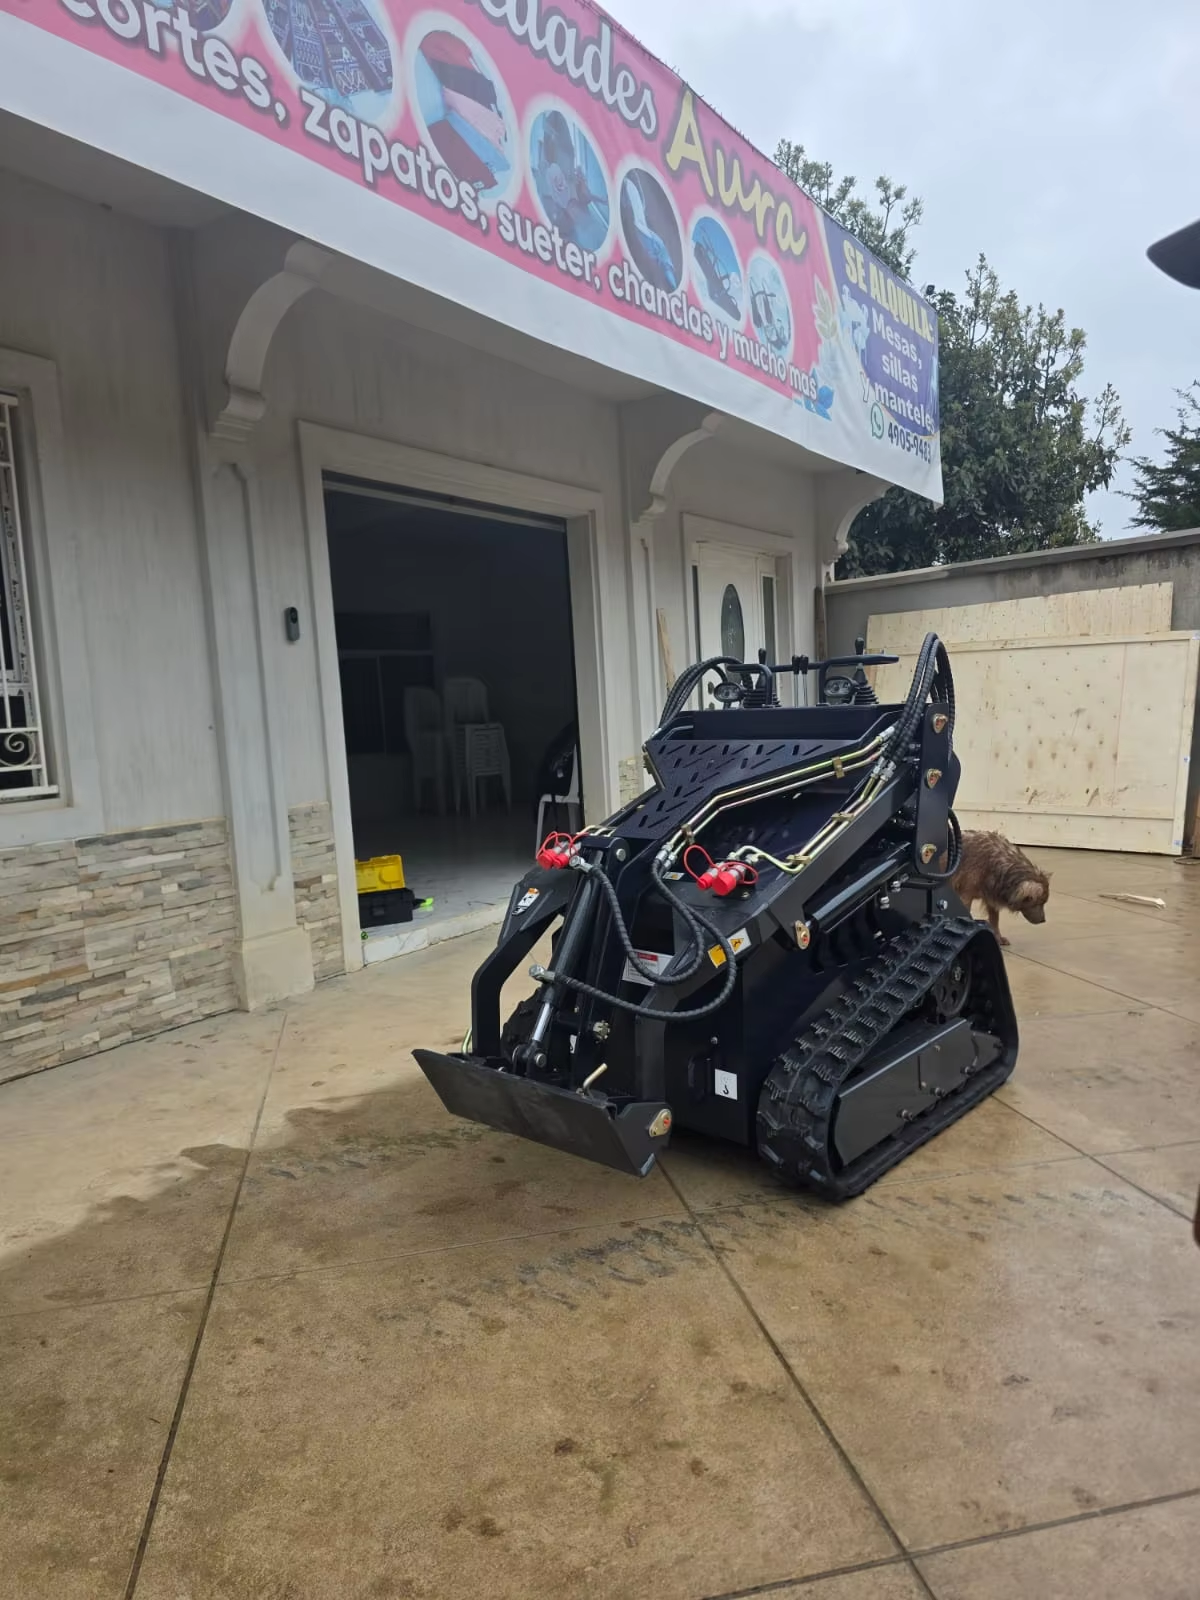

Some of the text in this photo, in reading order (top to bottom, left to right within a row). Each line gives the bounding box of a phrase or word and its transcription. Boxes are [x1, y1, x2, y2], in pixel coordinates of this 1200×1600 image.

[666, 91, 807, 256] Aura
[302, 92, 489, 231] zapatos,
[498, 203, 601, 289] sueter,
[609, 263, 713, 344] chanclas
[716, 321, 730, 360] y
[734, 328, 787, 381] mucho
[789, 362, 818, 400] mas
[843, 239, 936, 345] SE ALQUILA:
[871, 306, 923, 371] Mesas,
[881, 351, 919, 393] sillas
[860, 371, 936, 435] y manteles
